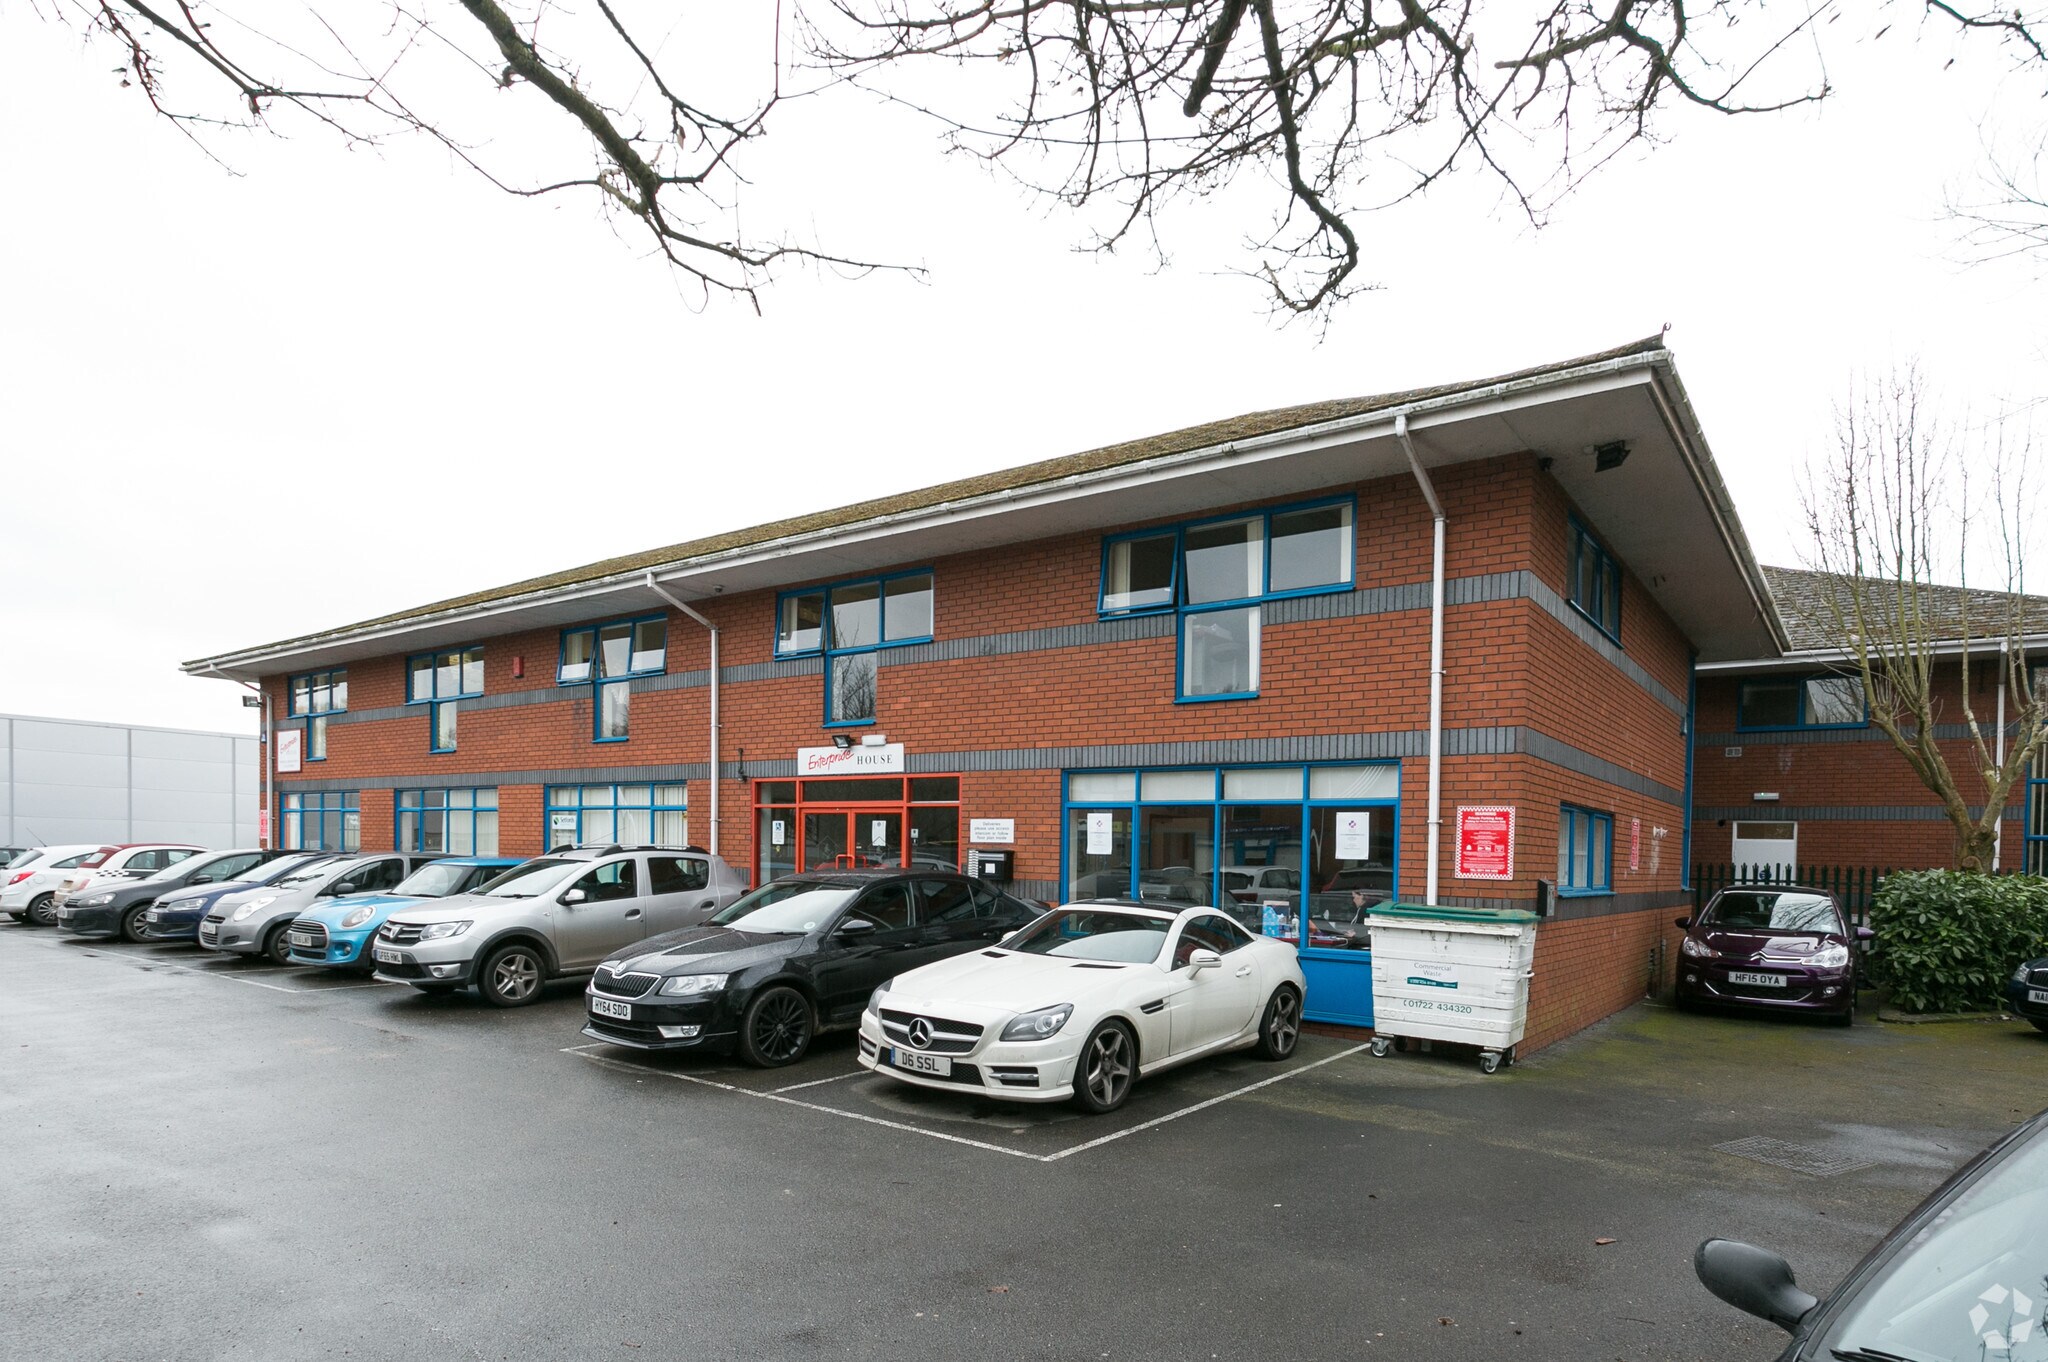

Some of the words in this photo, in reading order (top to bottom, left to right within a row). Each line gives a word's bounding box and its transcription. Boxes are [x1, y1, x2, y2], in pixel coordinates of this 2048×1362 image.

[808, 749, 855, 770] Enterprise
[857, 754, 893, 765] HOUSE
[1414, 962, 1452, 971] Commercial
[1735, 973, 1758, 983] HF15
[1760, 975, 1780, 985] OYA
[595, 999, 611, 1013] HY64
[612, 1003, 628, 1017] SDO
[1408, 1000, 1434, 1009] 01722
[1436, 1003, 1472, 1014] 434320
[902, 1052, 914, 1067] D6
[916, 1056, 940, 1072] SSL
